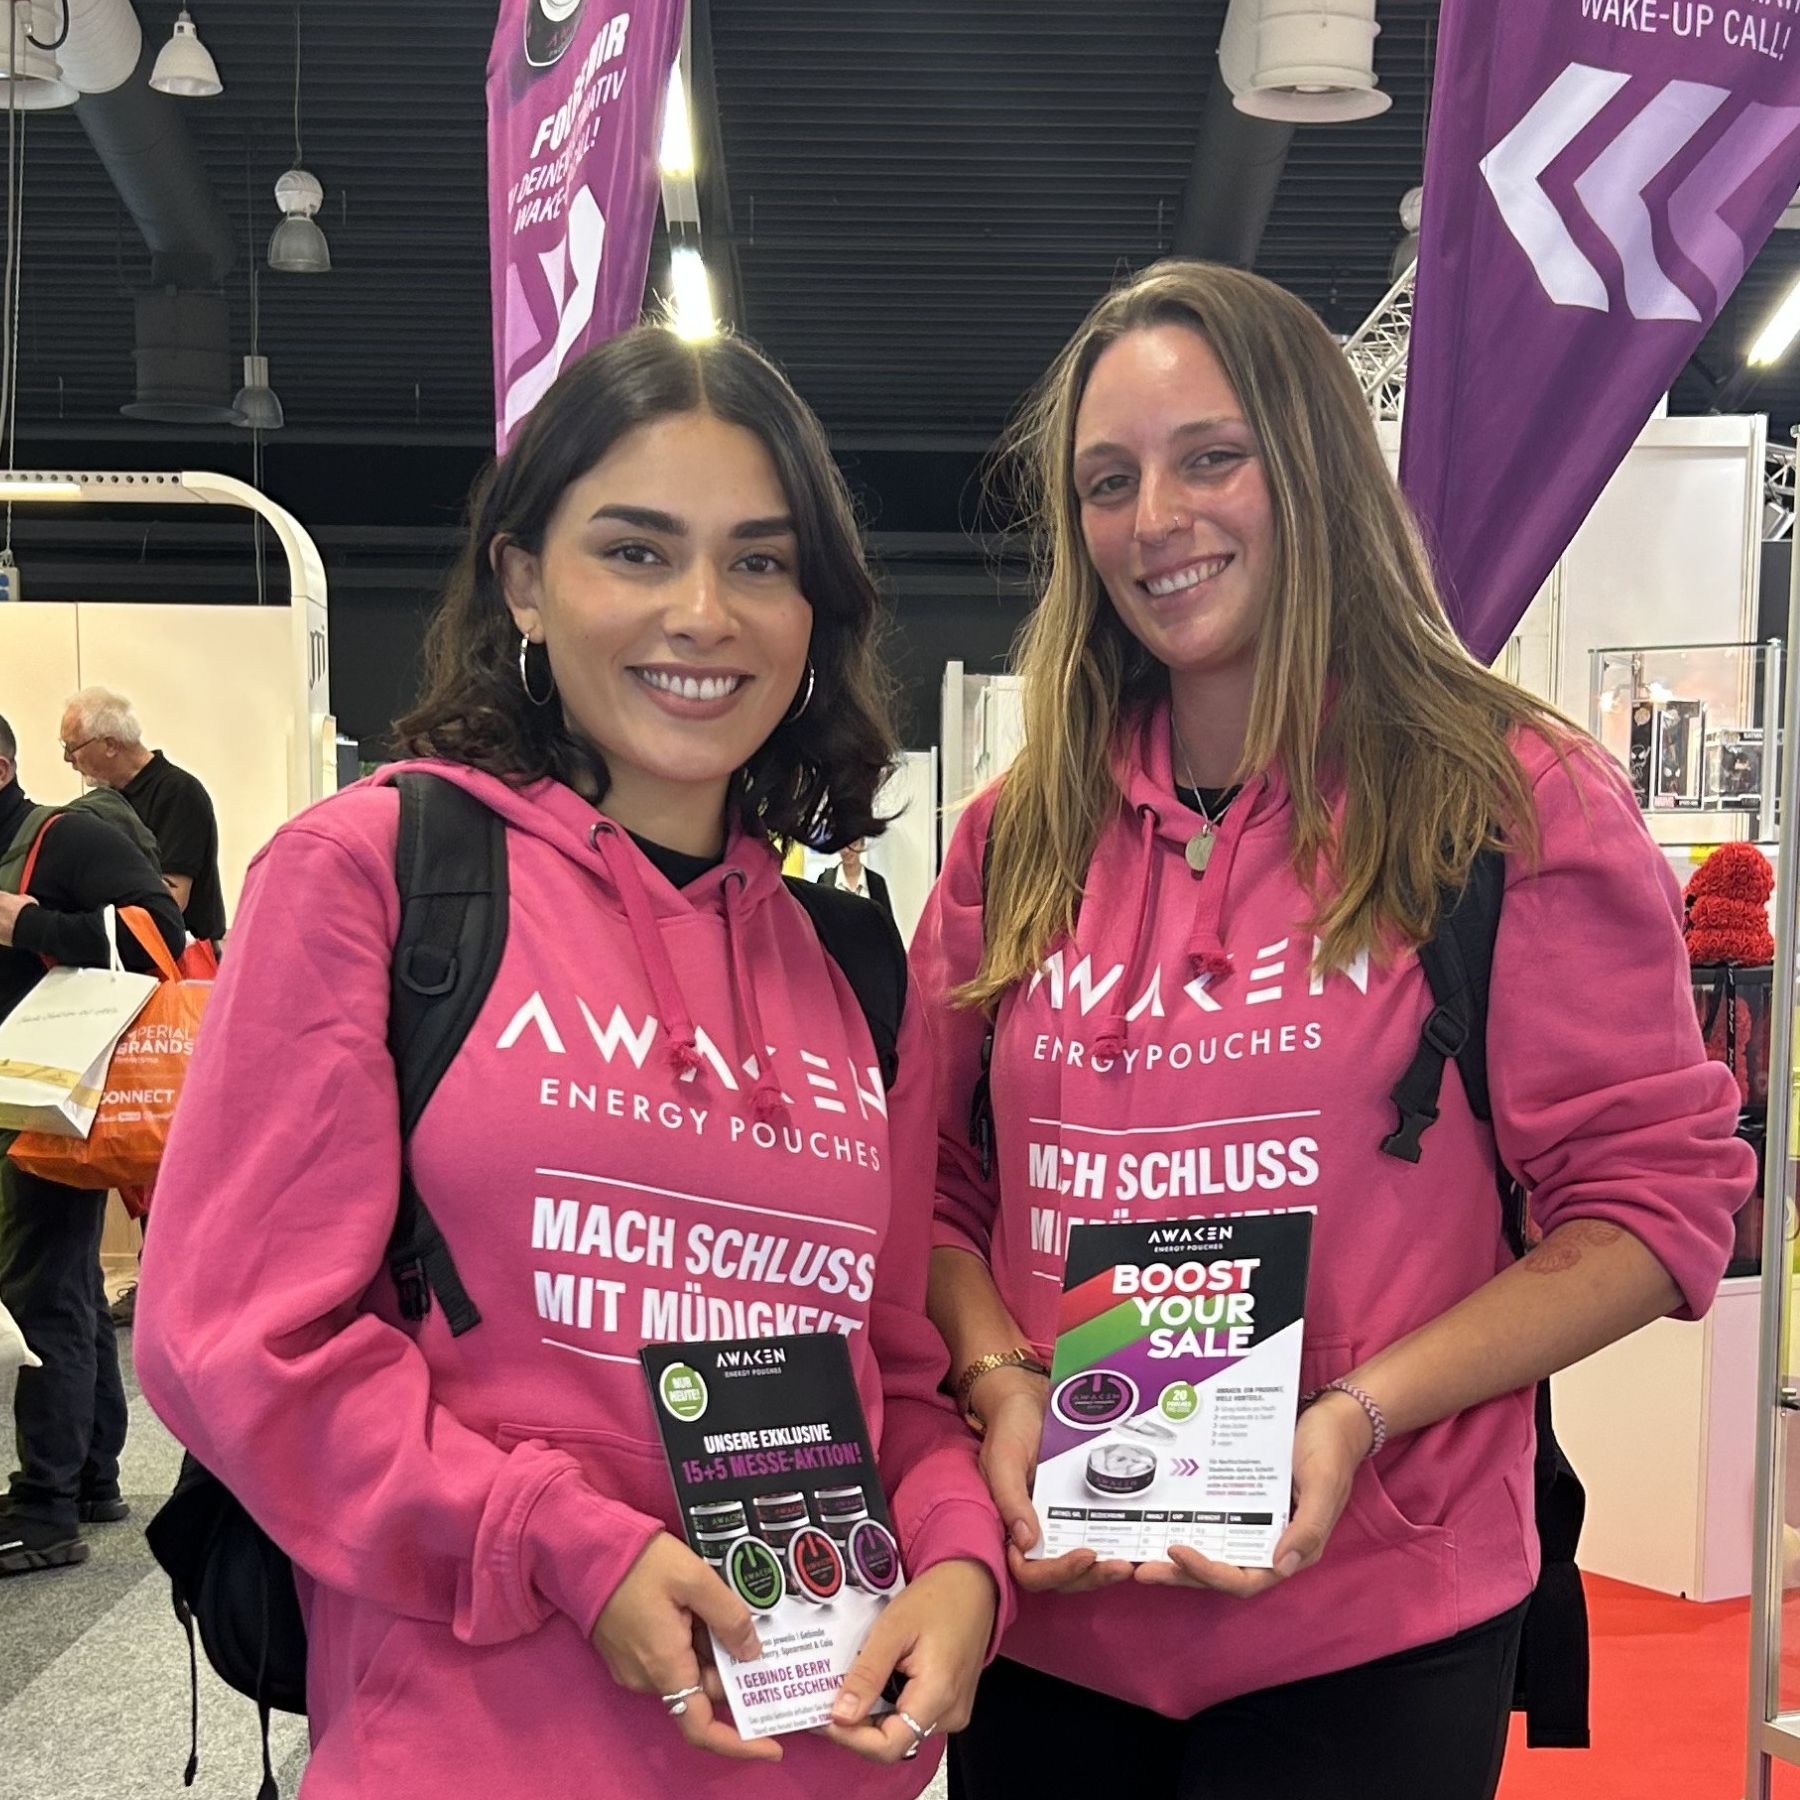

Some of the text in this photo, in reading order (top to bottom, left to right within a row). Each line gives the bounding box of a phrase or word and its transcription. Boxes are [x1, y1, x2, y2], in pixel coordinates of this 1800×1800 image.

[1581, 0, 1791, 61] WAKE-UP CALL!
[116, 1039, 194, 1055] BRANDS
[128, 1025, 192, 1041] PERIAL
[1146, 1022, 1322, 1070] POUCHES
[540, 1078, 880, 1171] ENERGY POUCHES
[1028, 1136, 1319, 1200] MCH SCHLUSS
[531, 1197, 876, 1302] MACH SCHLUSS
[1148, 1226, 1233, 1244] AWAKEN
[1154, 1243, 1224, 1253] ENERGY POUCHES
[1112, 1258, 1261, 1294] BOOST
[534, 1271, 626, 1332] MIT
[1131, 1292, 1255, 1326] YOUR
[716, 1348, 786, 1368] AWAKEN
[1147, 1326, 1255, 1359] SALE
[669, 1388, 701, 1402] HEUTE!
[671, 1376, 692, 1389] NUR
[1173, 1390, 1188, 1401] 20
[703, 1423, 832, 1454] UNSERE EXKLUSIVE
[681, 1442, 863, 1484] 15+5 MESSE-AKTION!
[744, 1666, 794, 1688] GEBINDE
[795, 1658, 831, 1678] BERRY
[742, 1687, 782, 1707] GRATIS
